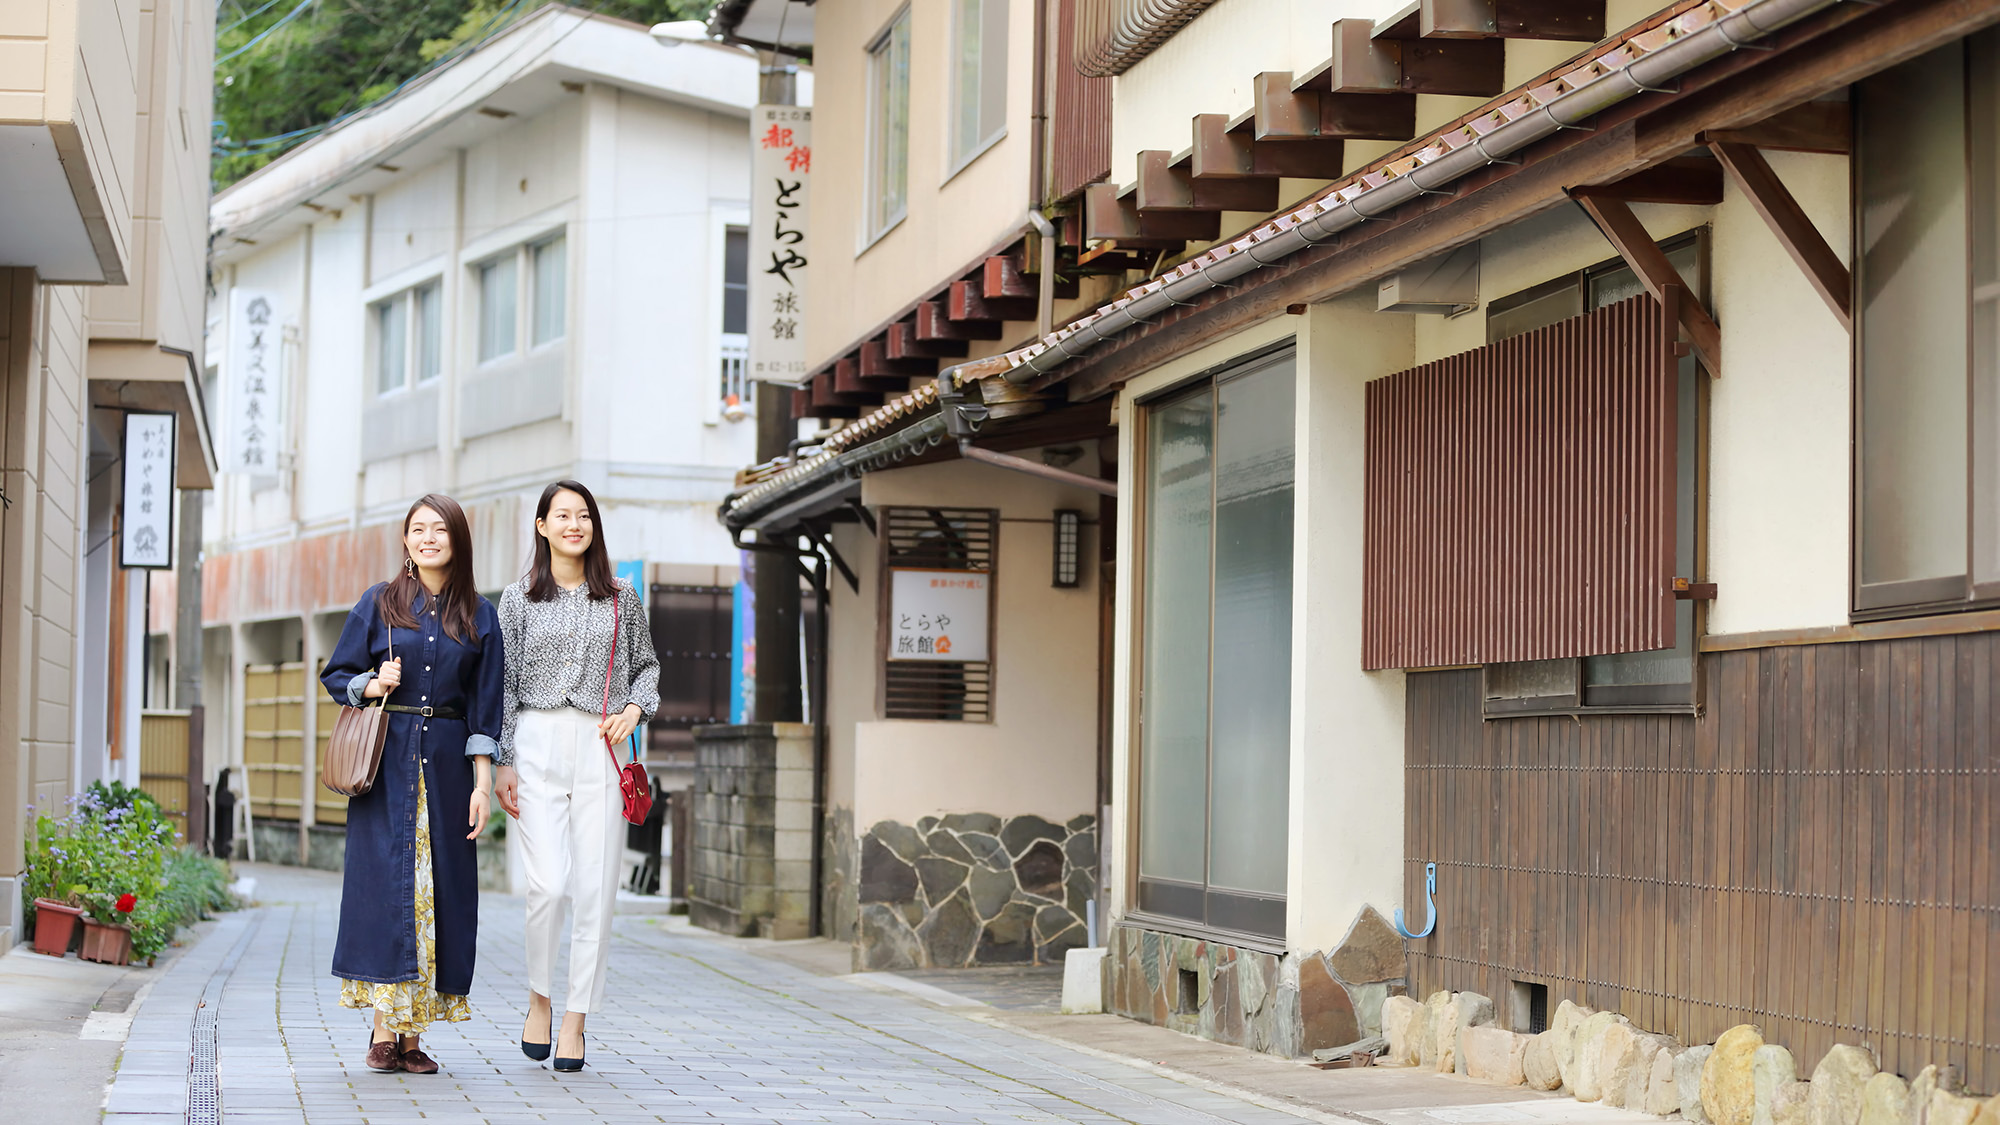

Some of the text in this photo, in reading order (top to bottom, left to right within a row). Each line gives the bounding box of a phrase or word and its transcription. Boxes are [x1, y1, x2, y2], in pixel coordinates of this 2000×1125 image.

[141, 428, 156, 514] かめや旅館
[900, 613, 951, 631] とらや
[897, 635, 934, 654] 旅館
